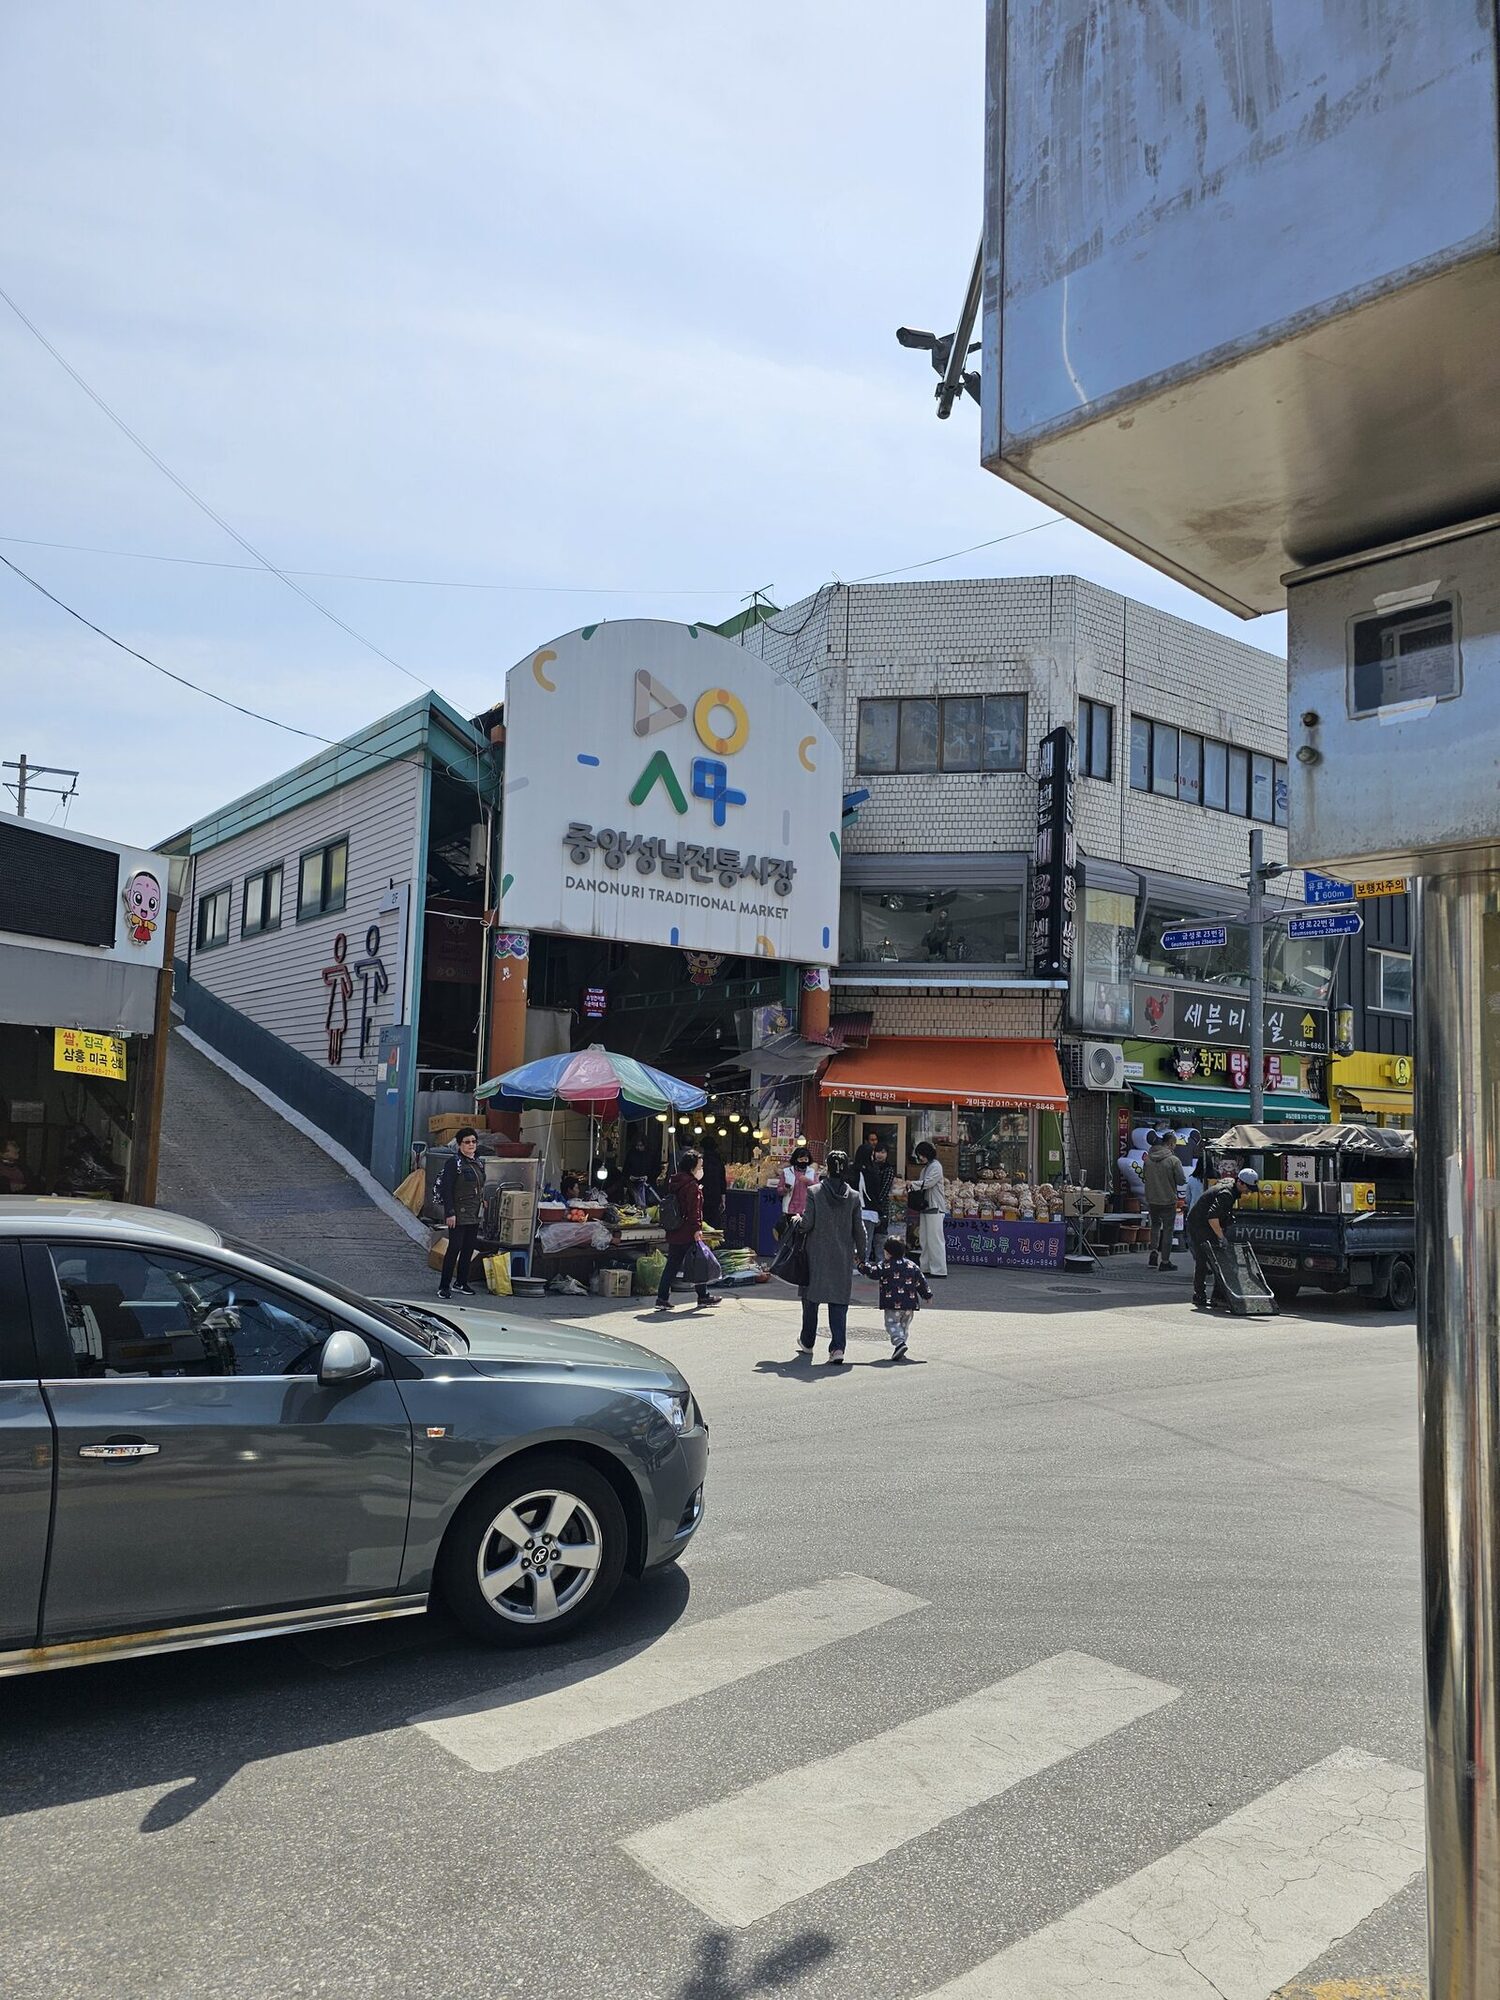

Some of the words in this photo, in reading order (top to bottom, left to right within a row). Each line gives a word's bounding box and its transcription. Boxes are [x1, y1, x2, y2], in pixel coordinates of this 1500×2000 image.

[562, 822, 798, 897] 중앙성남전통시장
[1322, 891, 1345, 899] 600m
[1357, 879, 1404, 895] 보행자주의
[565, 875, 646, 900] DANONURI
[648, 888, 736, 913] TRADITIONAL
[739, 903, 789, 920] MARKET
[1184, 1003, 1285, 1043] 세븐미실
[1304, 1025, 1314, 1035] 2F
[63, 1032, 79, 1047] 쌀,
[83, 1035, 107, 1053] 잡곡,
[89, 1052, 108, 1067] 미곡
[1199, 1051, 1227, 1077] 황제
[1231, 1053, 1281, 1090] 탕루
[1235, 1227, 1300, 1241] HYUNDAI
[1018, 1238, 1059, 1257] 건어물
